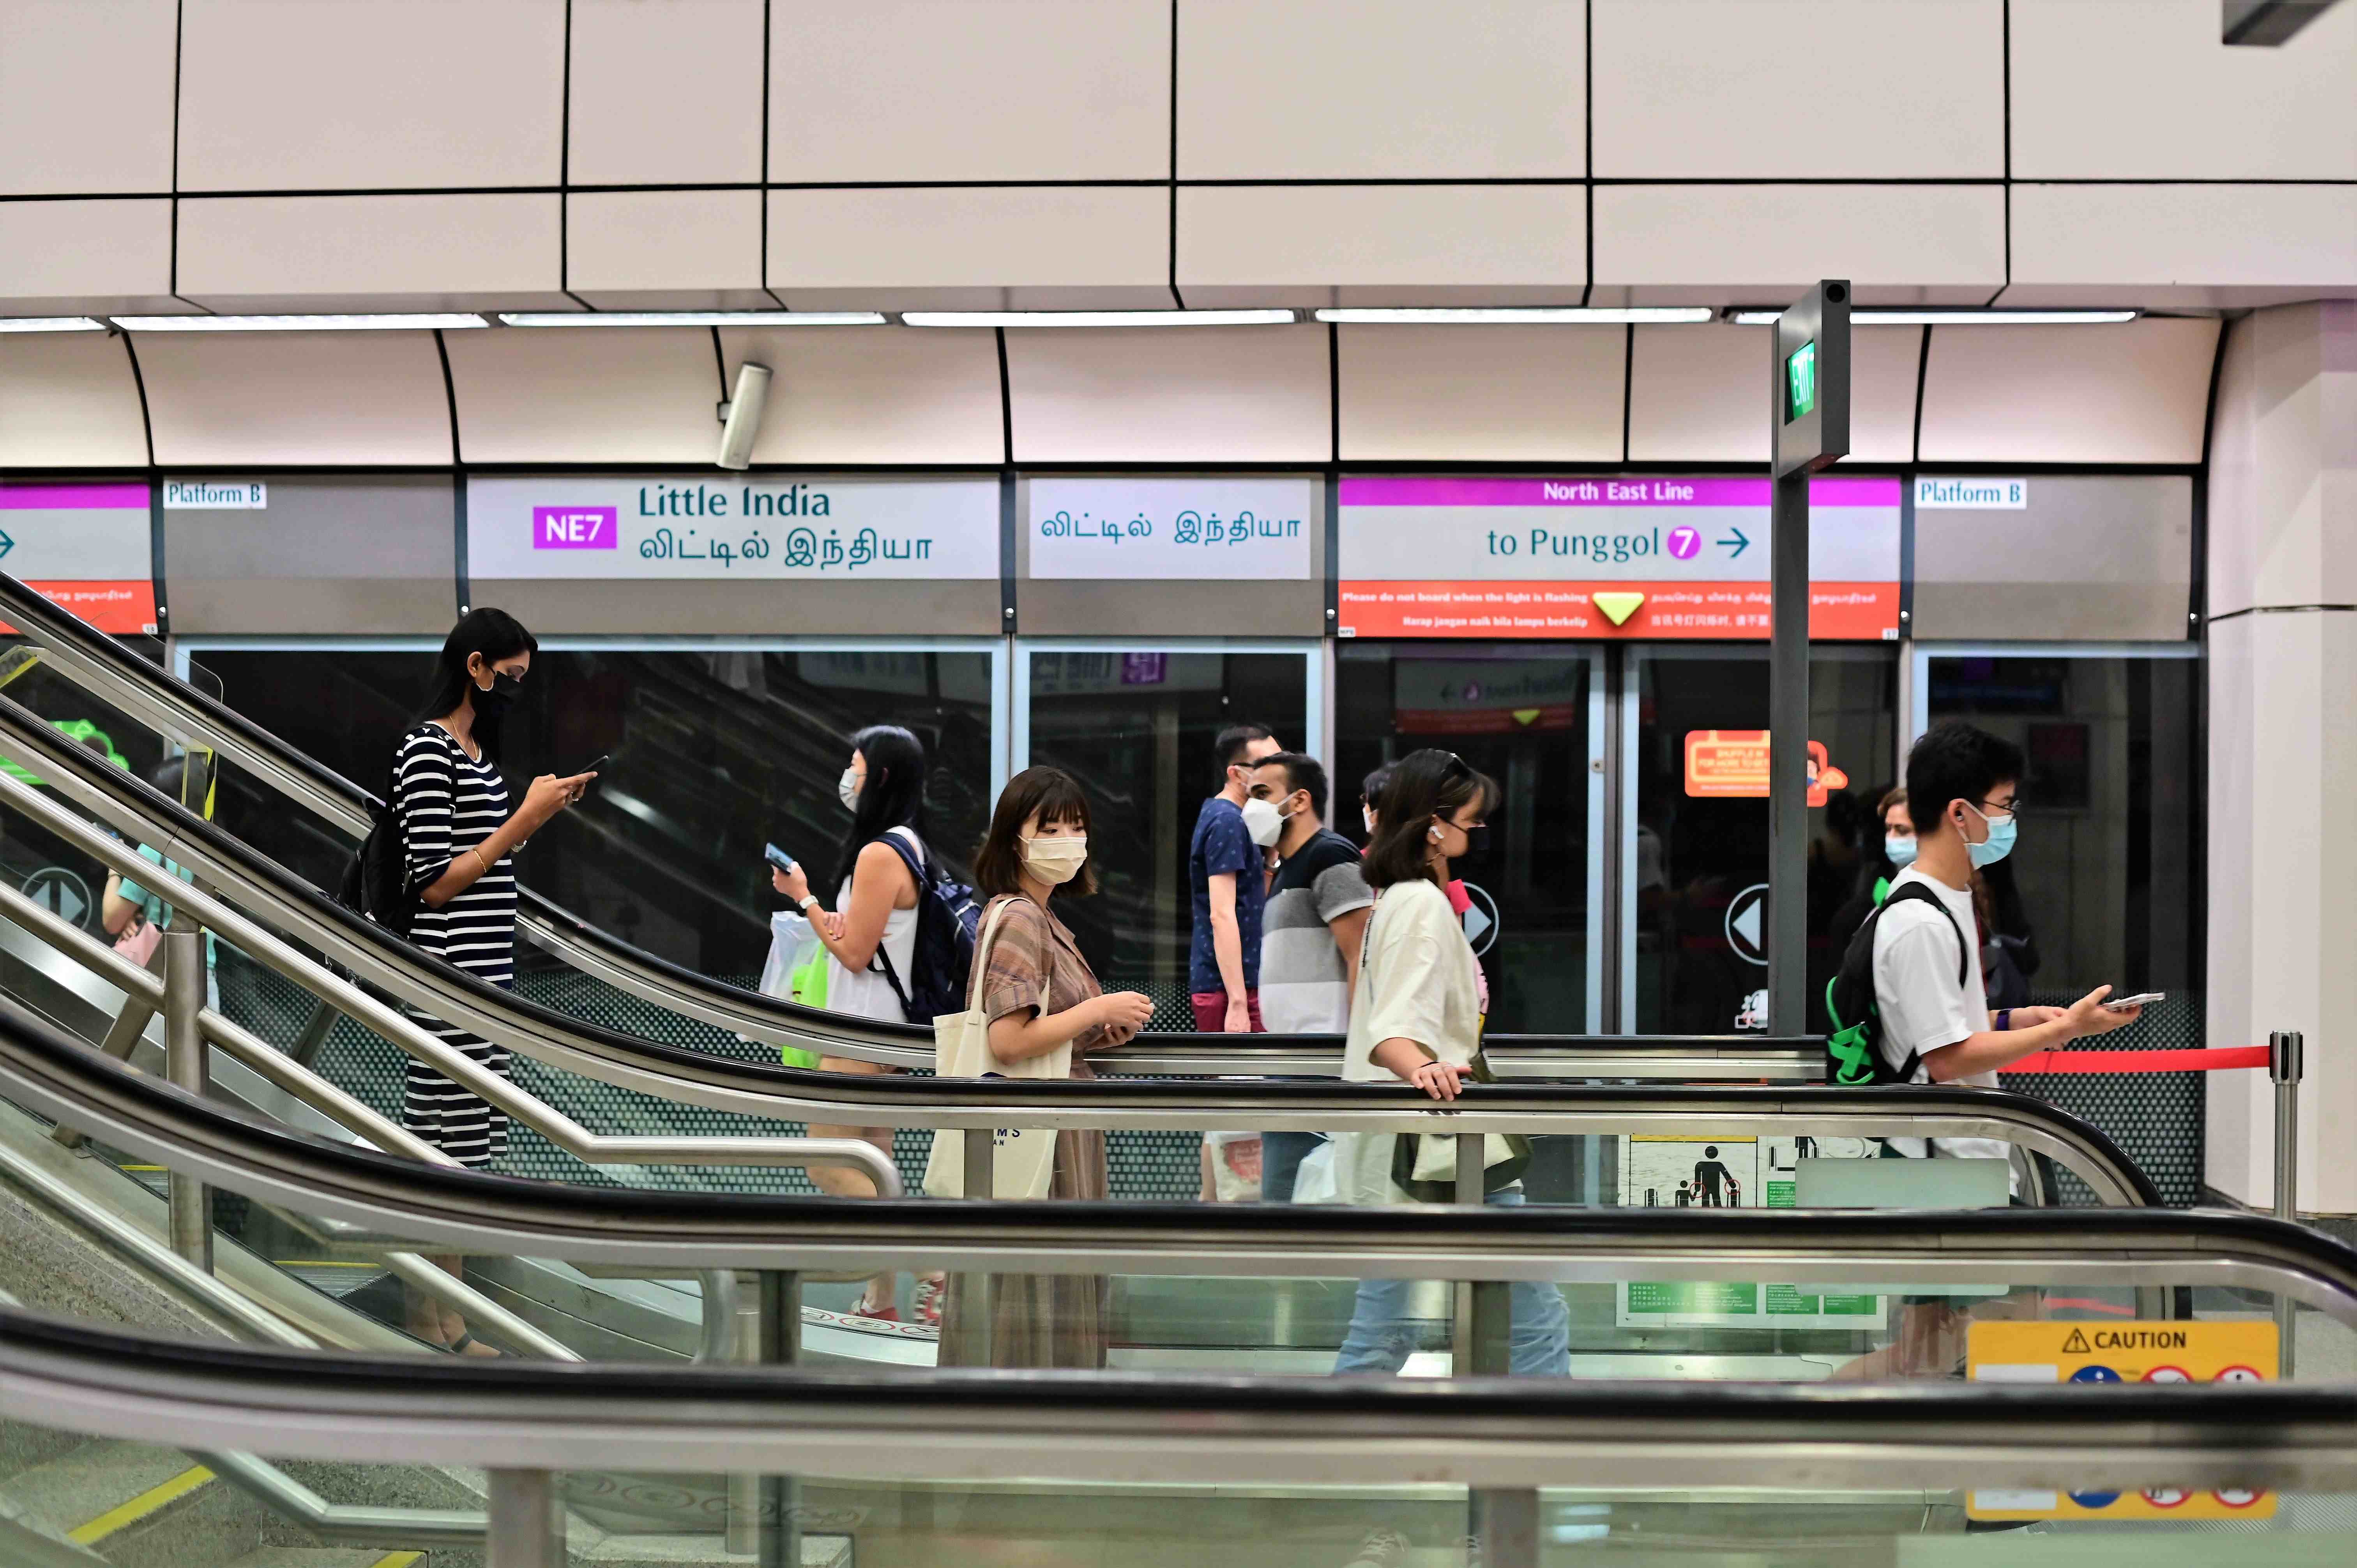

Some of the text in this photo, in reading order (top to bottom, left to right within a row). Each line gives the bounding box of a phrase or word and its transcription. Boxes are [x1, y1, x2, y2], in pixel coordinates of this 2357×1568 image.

[169, 484, 260, 502] Platform B
[640, 484, 830, 516] Little India
[1544, 482, 1694, 501] North East Line
[1921, 482, 2021, 502] Platform B
[546, 514, 604, 541] NE7
[1041, 510, 1301, 546] லிட்டில் இந்தியா
[640, 527, 933, 570] லிட்டில் இந்தியா
[1488, 527, 1694, 562] to Punggol 7
[1342, 592, 1588, 604] Please do not board when the light is flashing
[2095, 1331, 2186, 1349] CAUTION
